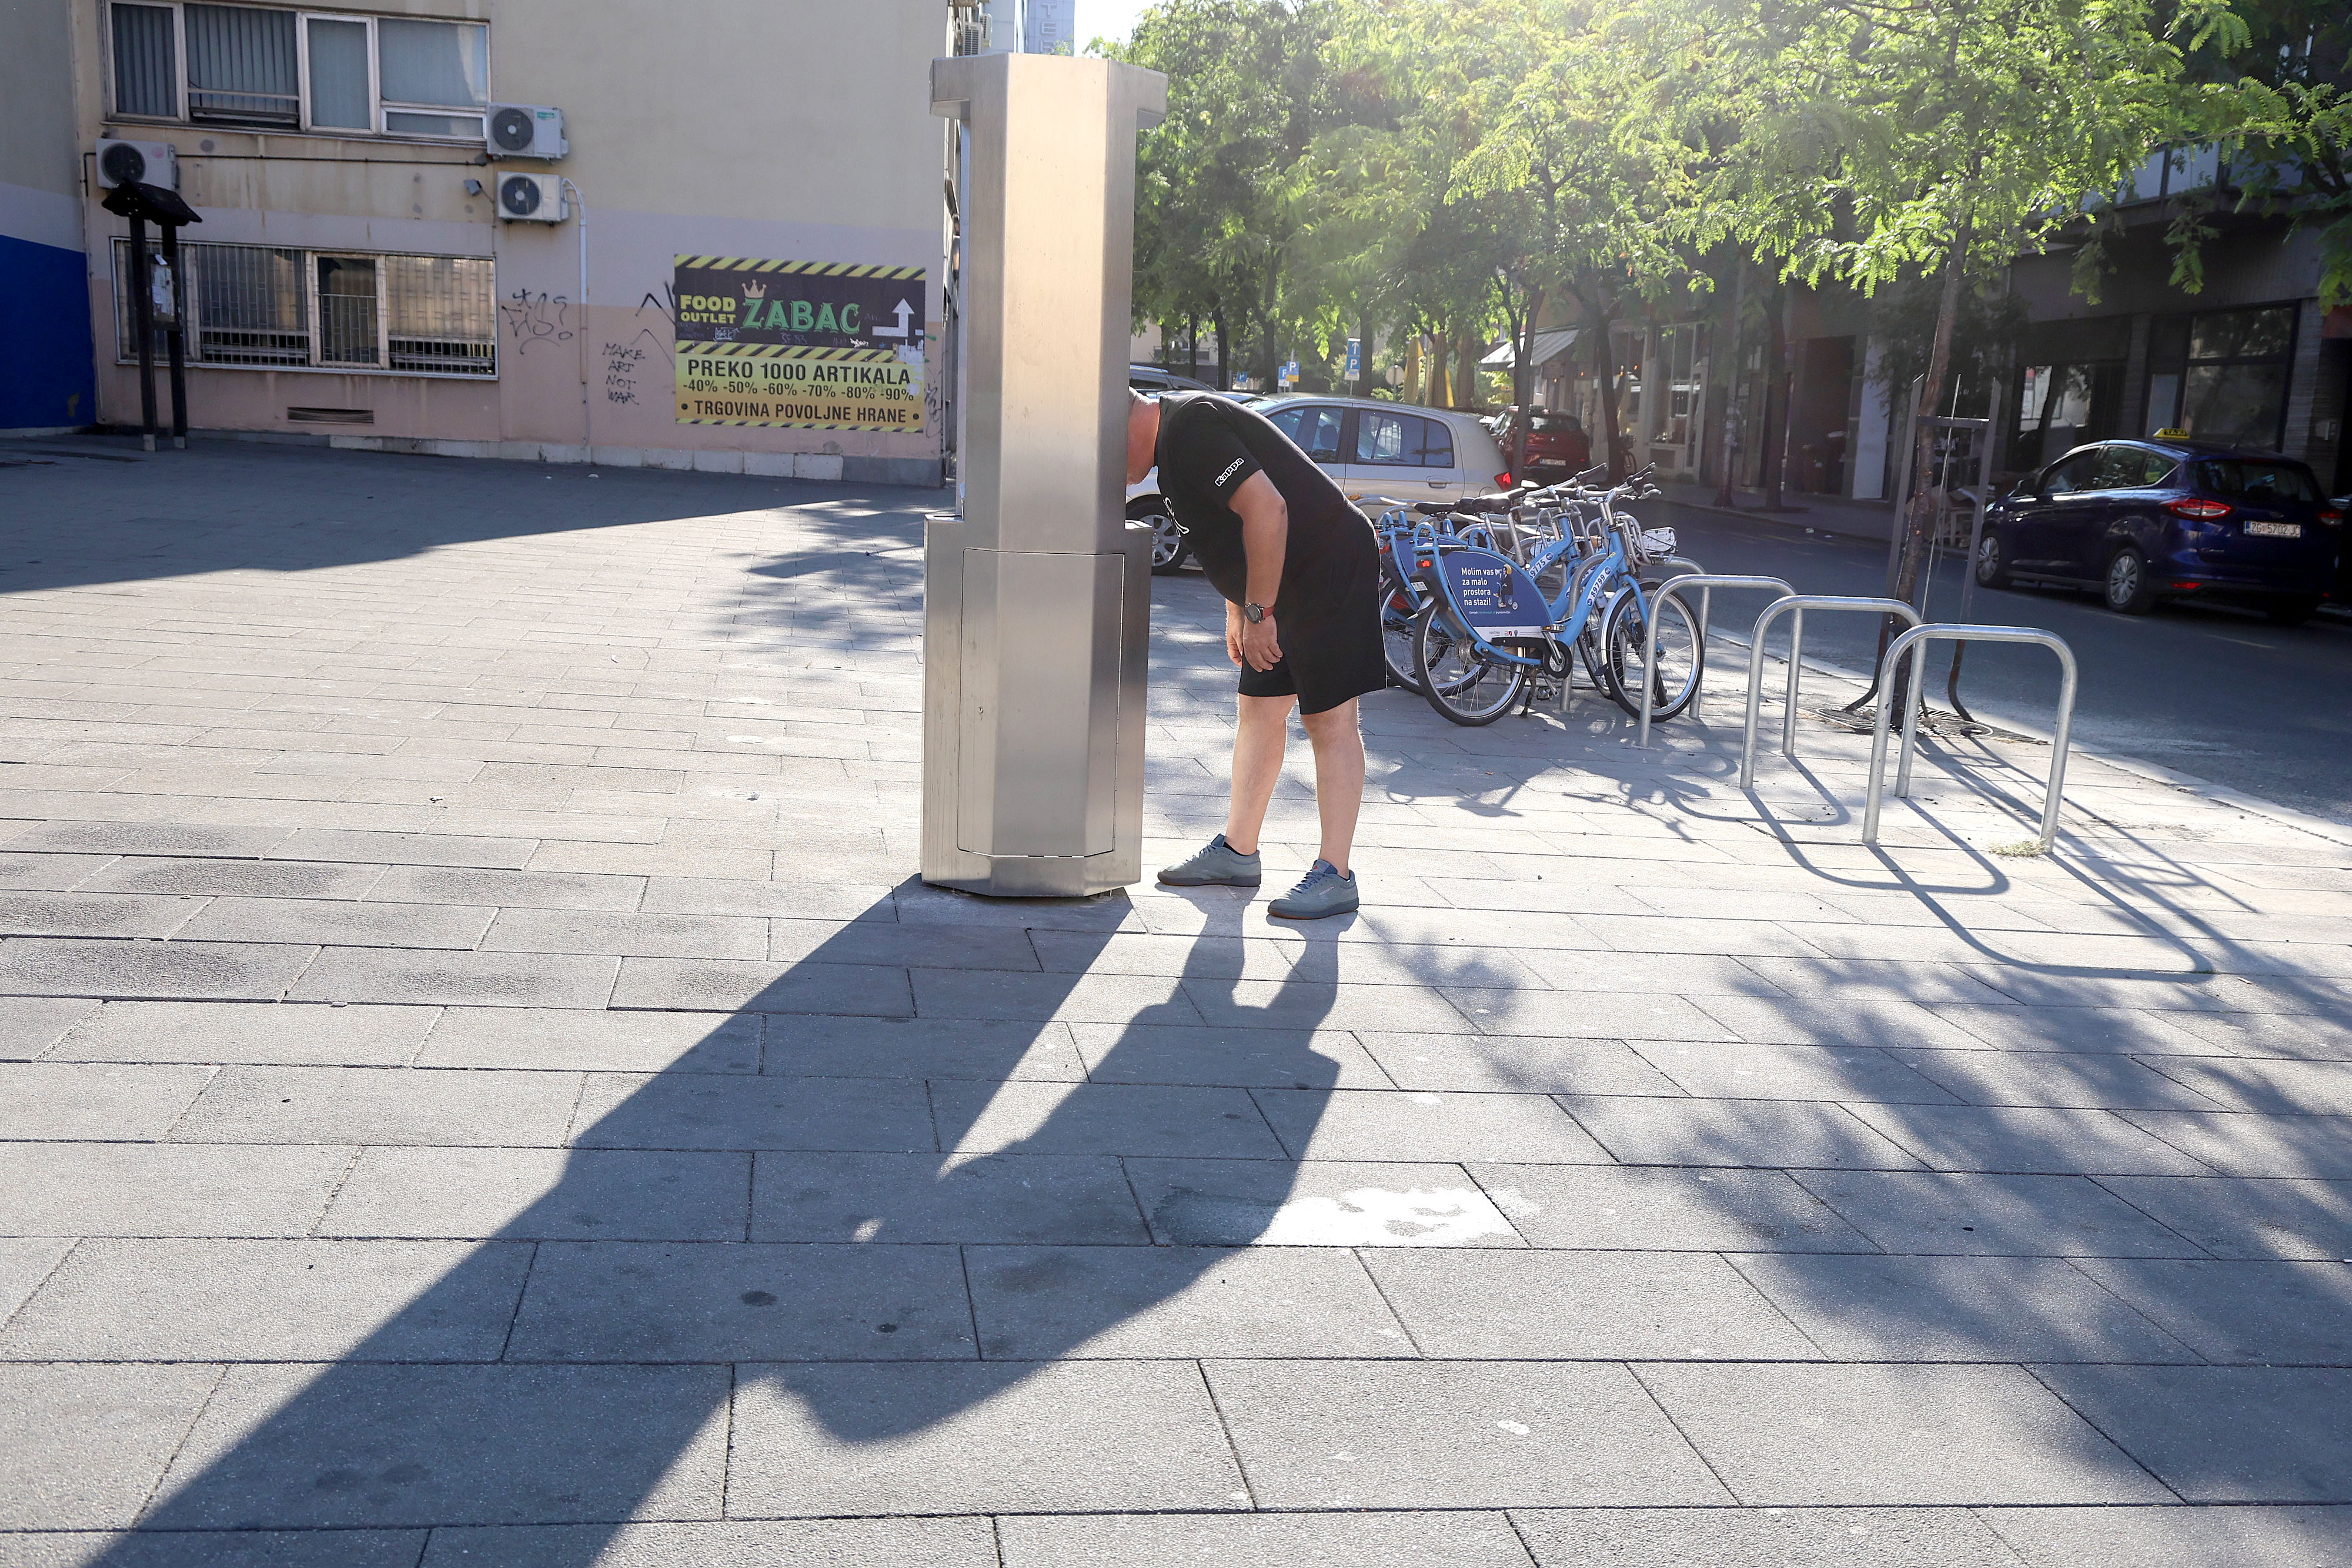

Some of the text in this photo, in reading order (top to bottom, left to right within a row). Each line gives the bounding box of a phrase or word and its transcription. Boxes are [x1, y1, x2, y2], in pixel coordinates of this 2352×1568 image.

[680, 295, 736, 312] FOOD
[680, 312, 736, 323] OUTLET
[602, 342, 646, 360] MAKE
[608, 359, 634, 372] ART
[687, 359, 910, 385] PREKO 1000 ARTIKALA
[1289, 362, 1297, 372] P
[1351, 359, 1358, 369] P
[606, 375, 636, 390] NOT
[683, 379, 914, 401] -40% -50% -60% -70% -80% -90%
[607, 388, 640, 405] WAR
[694, 400, 906, 423] TRGOVINA POVOLJNE HRANE
[1215, 457, 1245, 487] Kappa
[2252, 523, 2262, 533] ZG
[1463, 589, 1491, 597] prostora
[1591, 574, 1605, 597] 89799
[1474, 597, 1491, 606] stazi!
